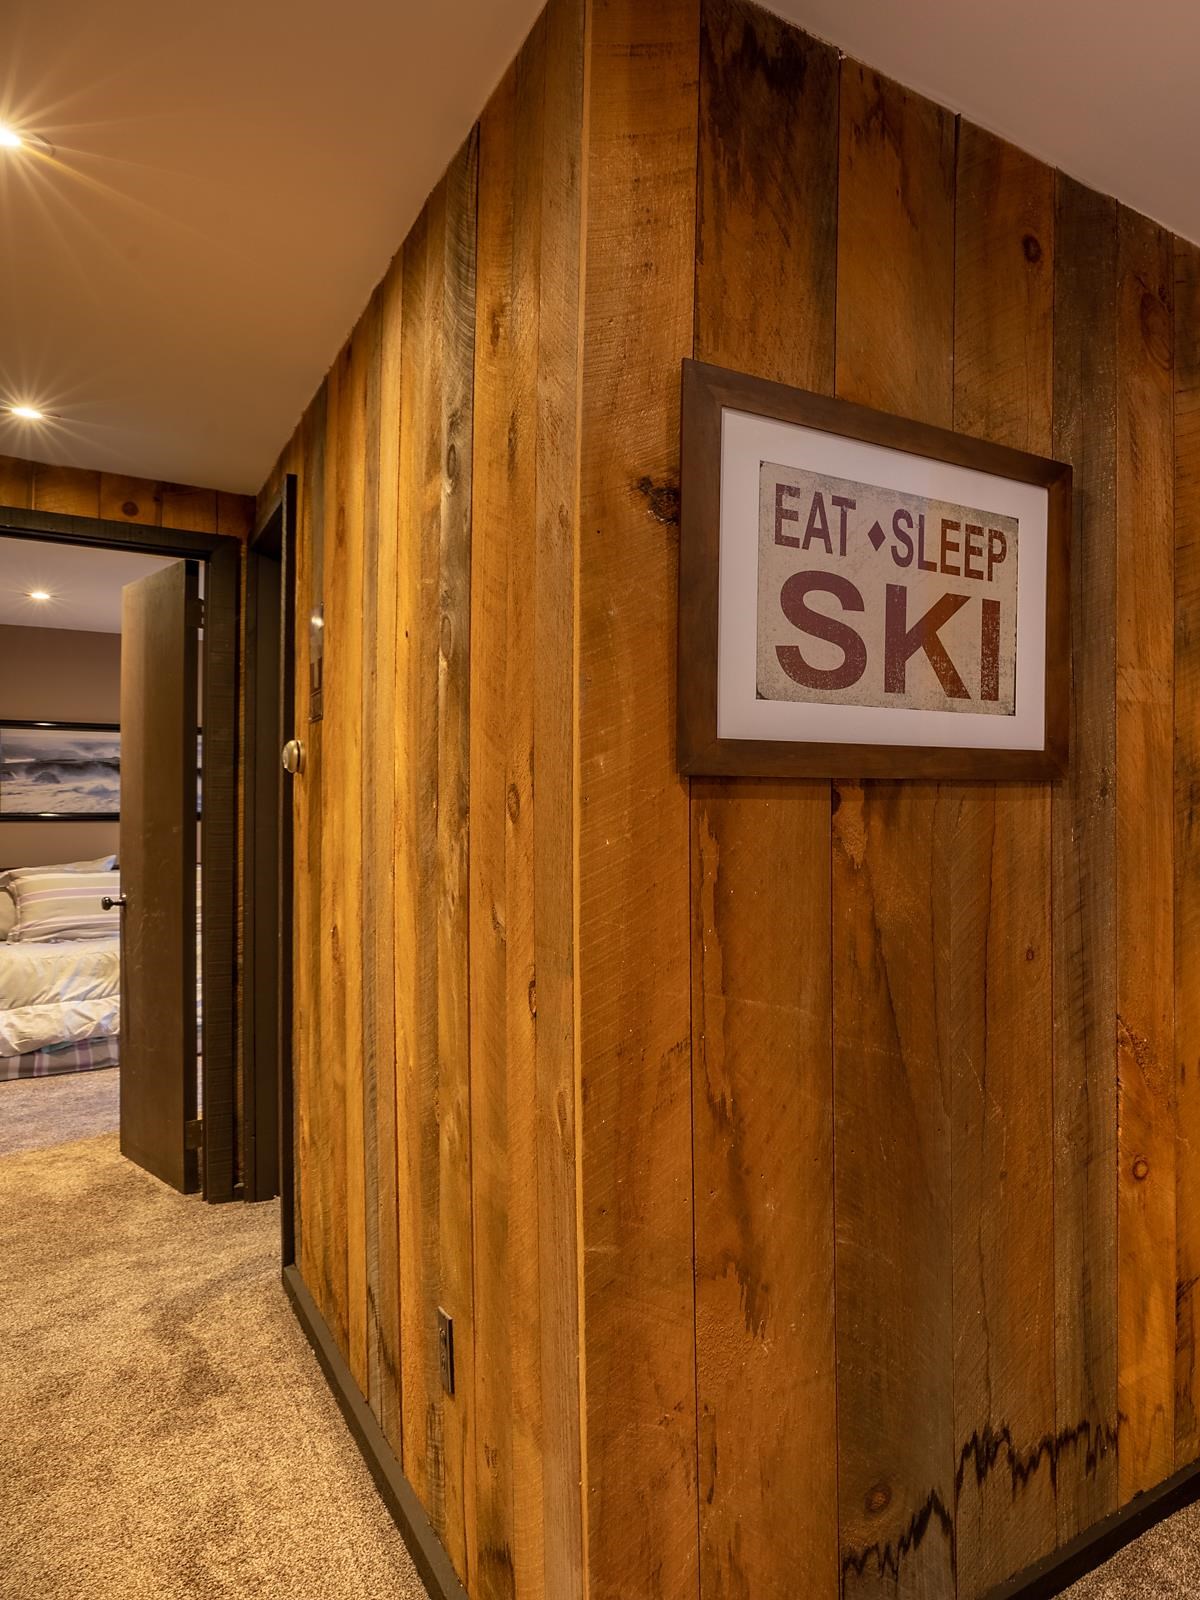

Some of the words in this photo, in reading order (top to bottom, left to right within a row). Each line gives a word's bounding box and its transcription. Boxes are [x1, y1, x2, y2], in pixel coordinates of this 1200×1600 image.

[774, 483, 856, 556] EAT
[891, 508, 1007, 582] SLEEP
[775, 570, 1001, 701] SKI
